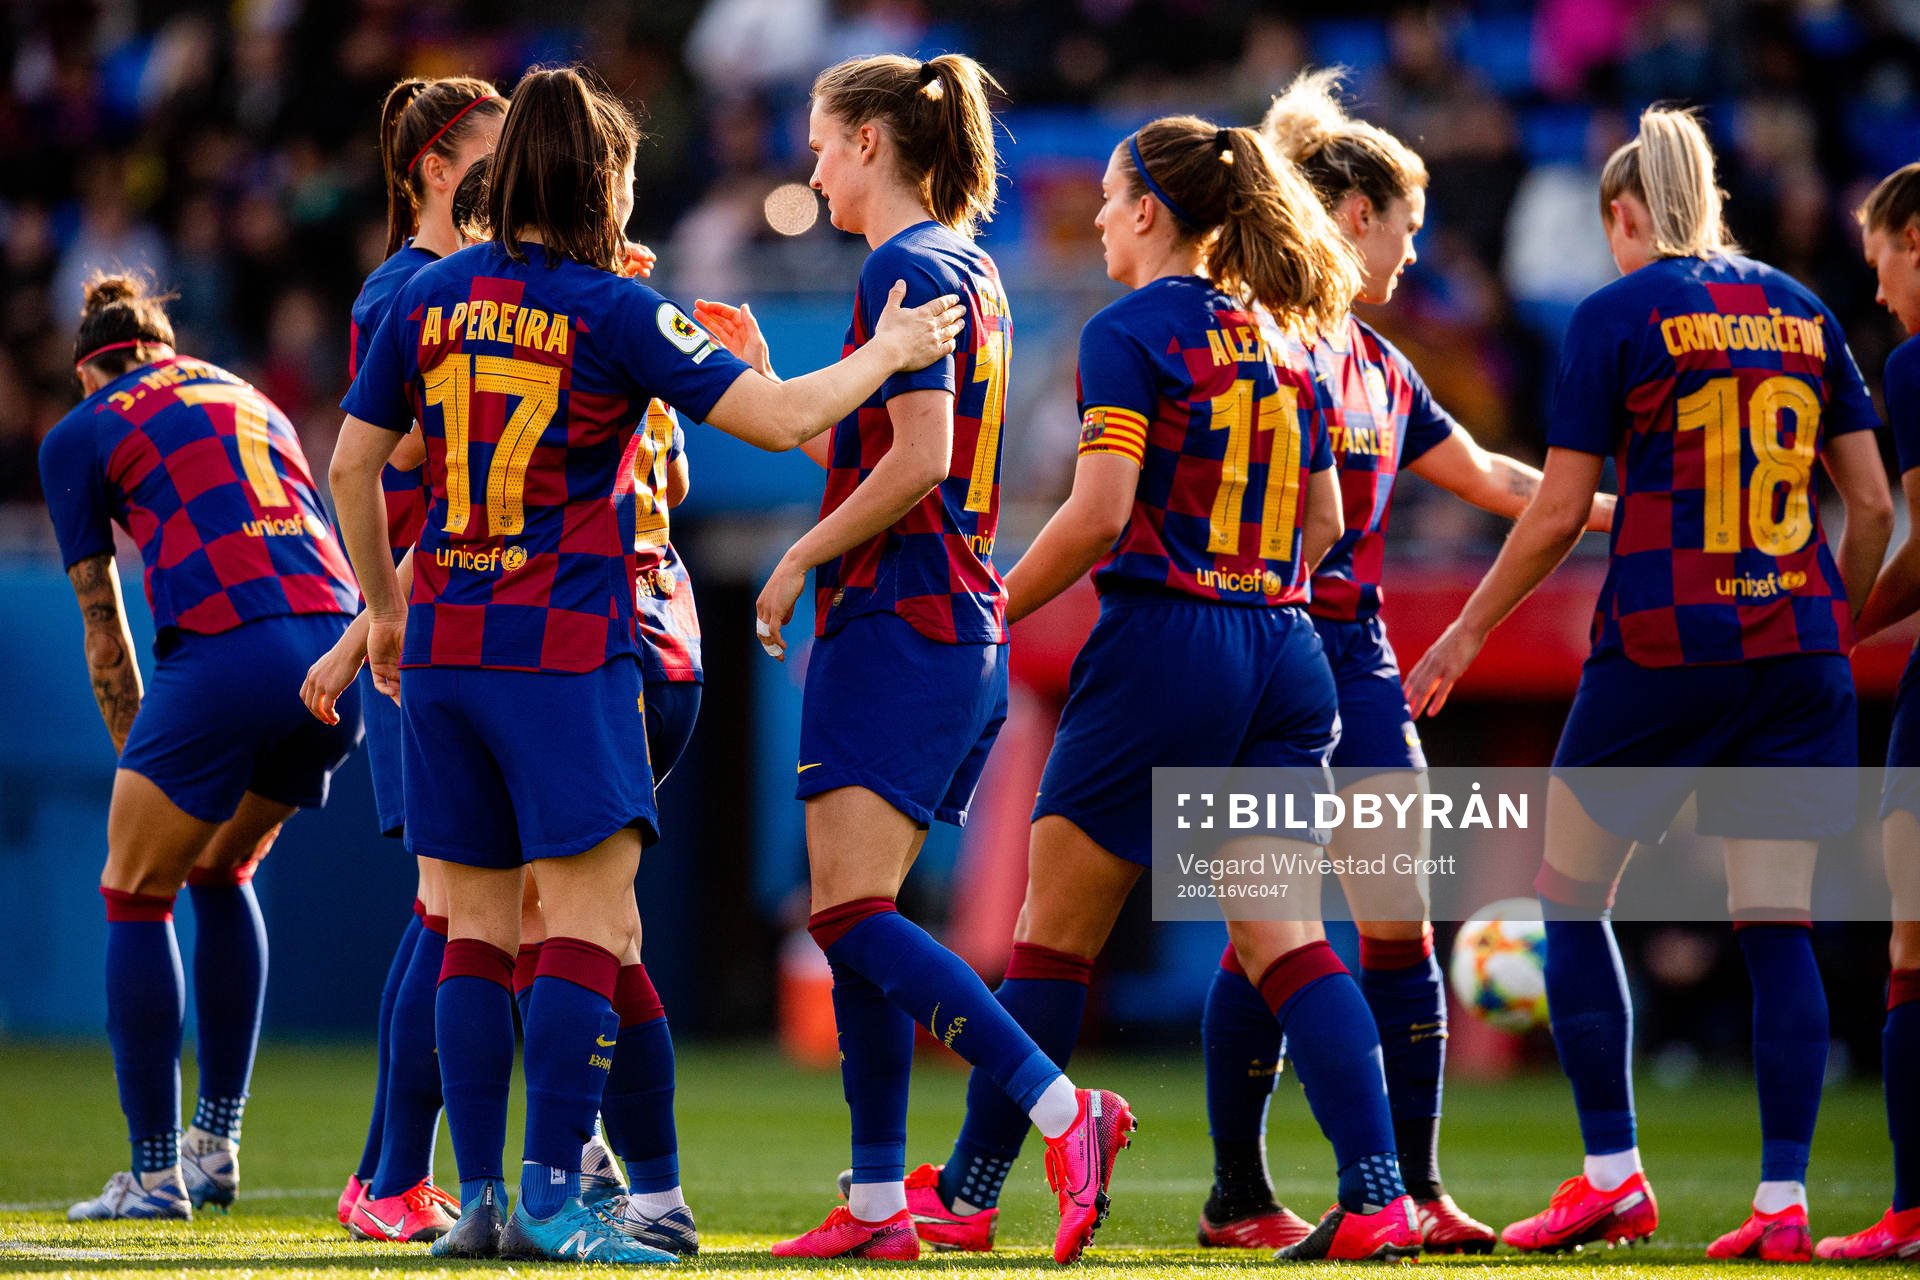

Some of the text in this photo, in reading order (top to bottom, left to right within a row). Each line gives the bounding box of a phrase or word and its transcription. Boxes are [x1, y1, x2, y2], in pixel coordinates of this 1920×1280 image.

[421, 300, 569, 354] A PEREIRA
[172, 383, 290, 508] 7
[421, 352, 563, 538] 17
[1206, 379, 1301, 562] 11
[1677, 376, 1821, 556] 18
[242, 514, 304, 538] unicef
[436, 545, 500, 572] unicef
[1196, 567, 1263, 593] unicef
[1715, 571, 1779, 598] unicef
